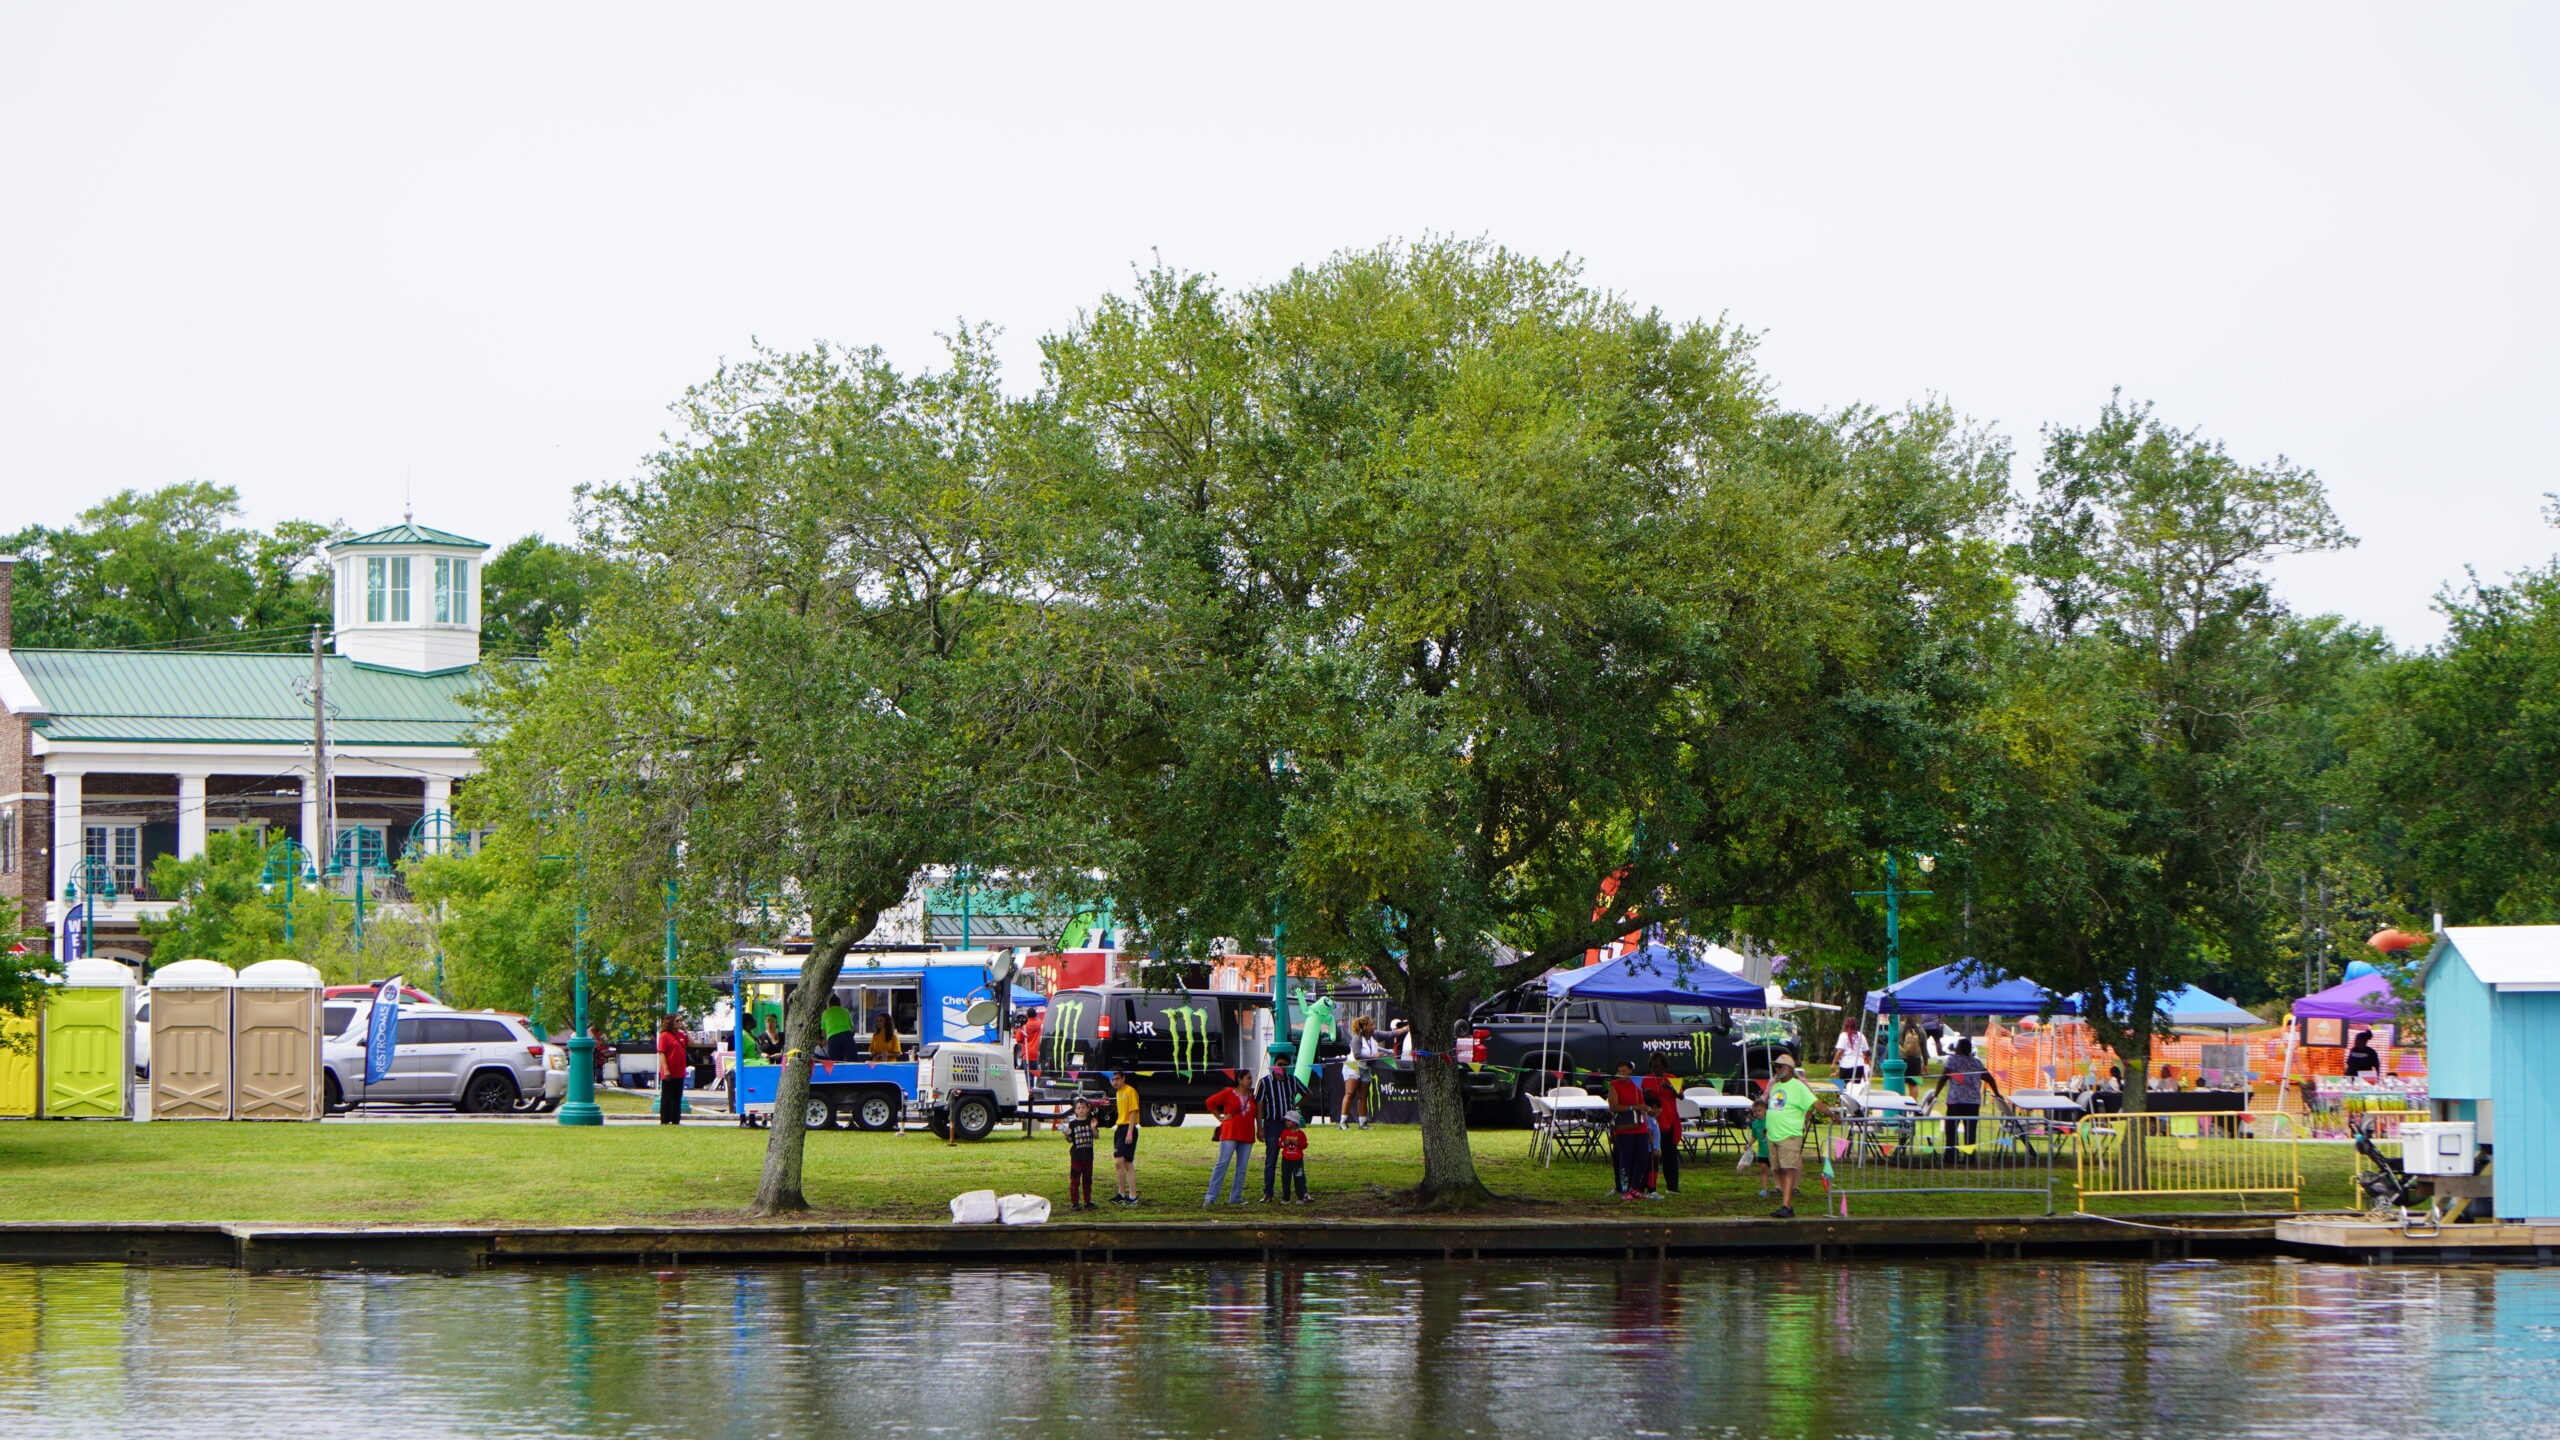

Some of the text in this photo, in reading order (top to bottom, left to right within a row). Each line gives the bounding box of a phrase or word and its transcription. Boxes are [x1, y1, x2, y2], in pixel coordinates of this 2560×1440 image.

[942, 995, 985, 1005] Chevon
[375, 1006, 389, 1073] RESTROOMS
[1642, 1039, 1692, 1051] MONSTER
